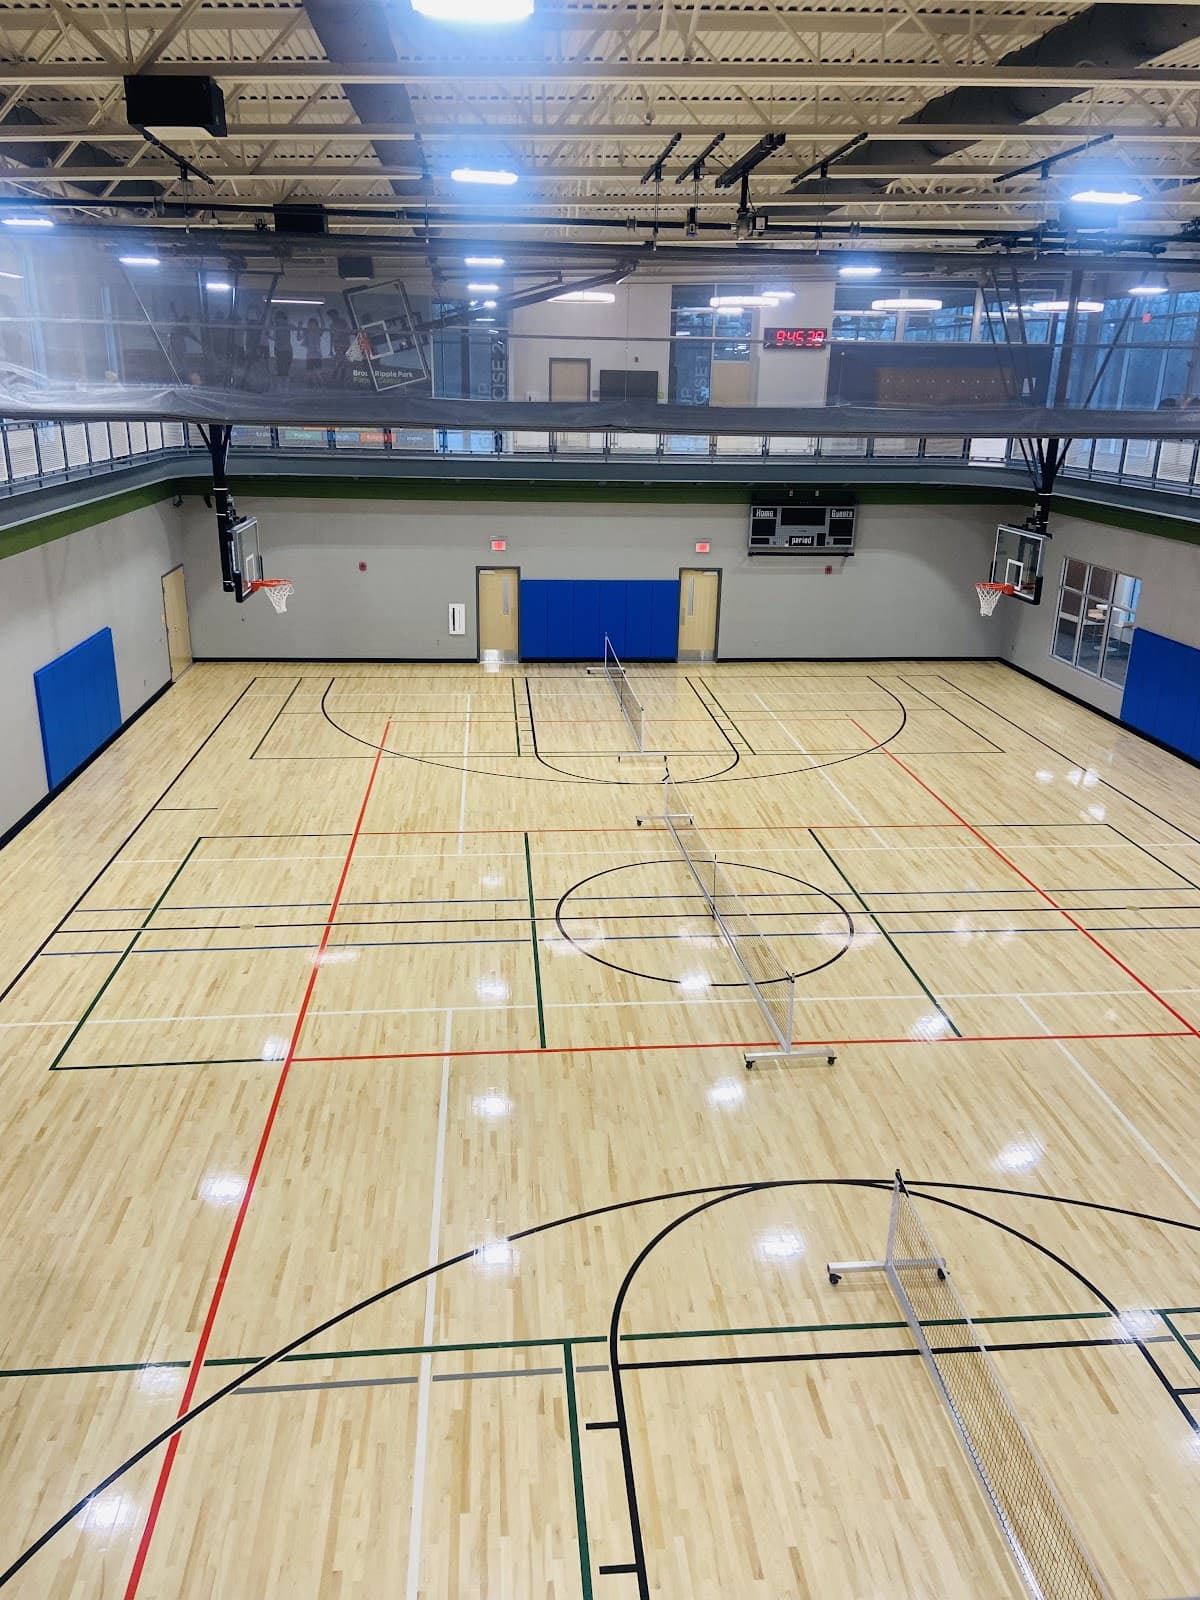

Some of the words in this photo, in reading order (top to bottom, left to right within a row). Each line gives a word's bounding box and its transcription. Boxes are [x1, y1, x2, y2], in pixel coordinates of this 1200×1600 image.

[756, 509, 774, 517] Home
[831, 510, 853, 518] Guests
[791, 536, 812, 545] period
